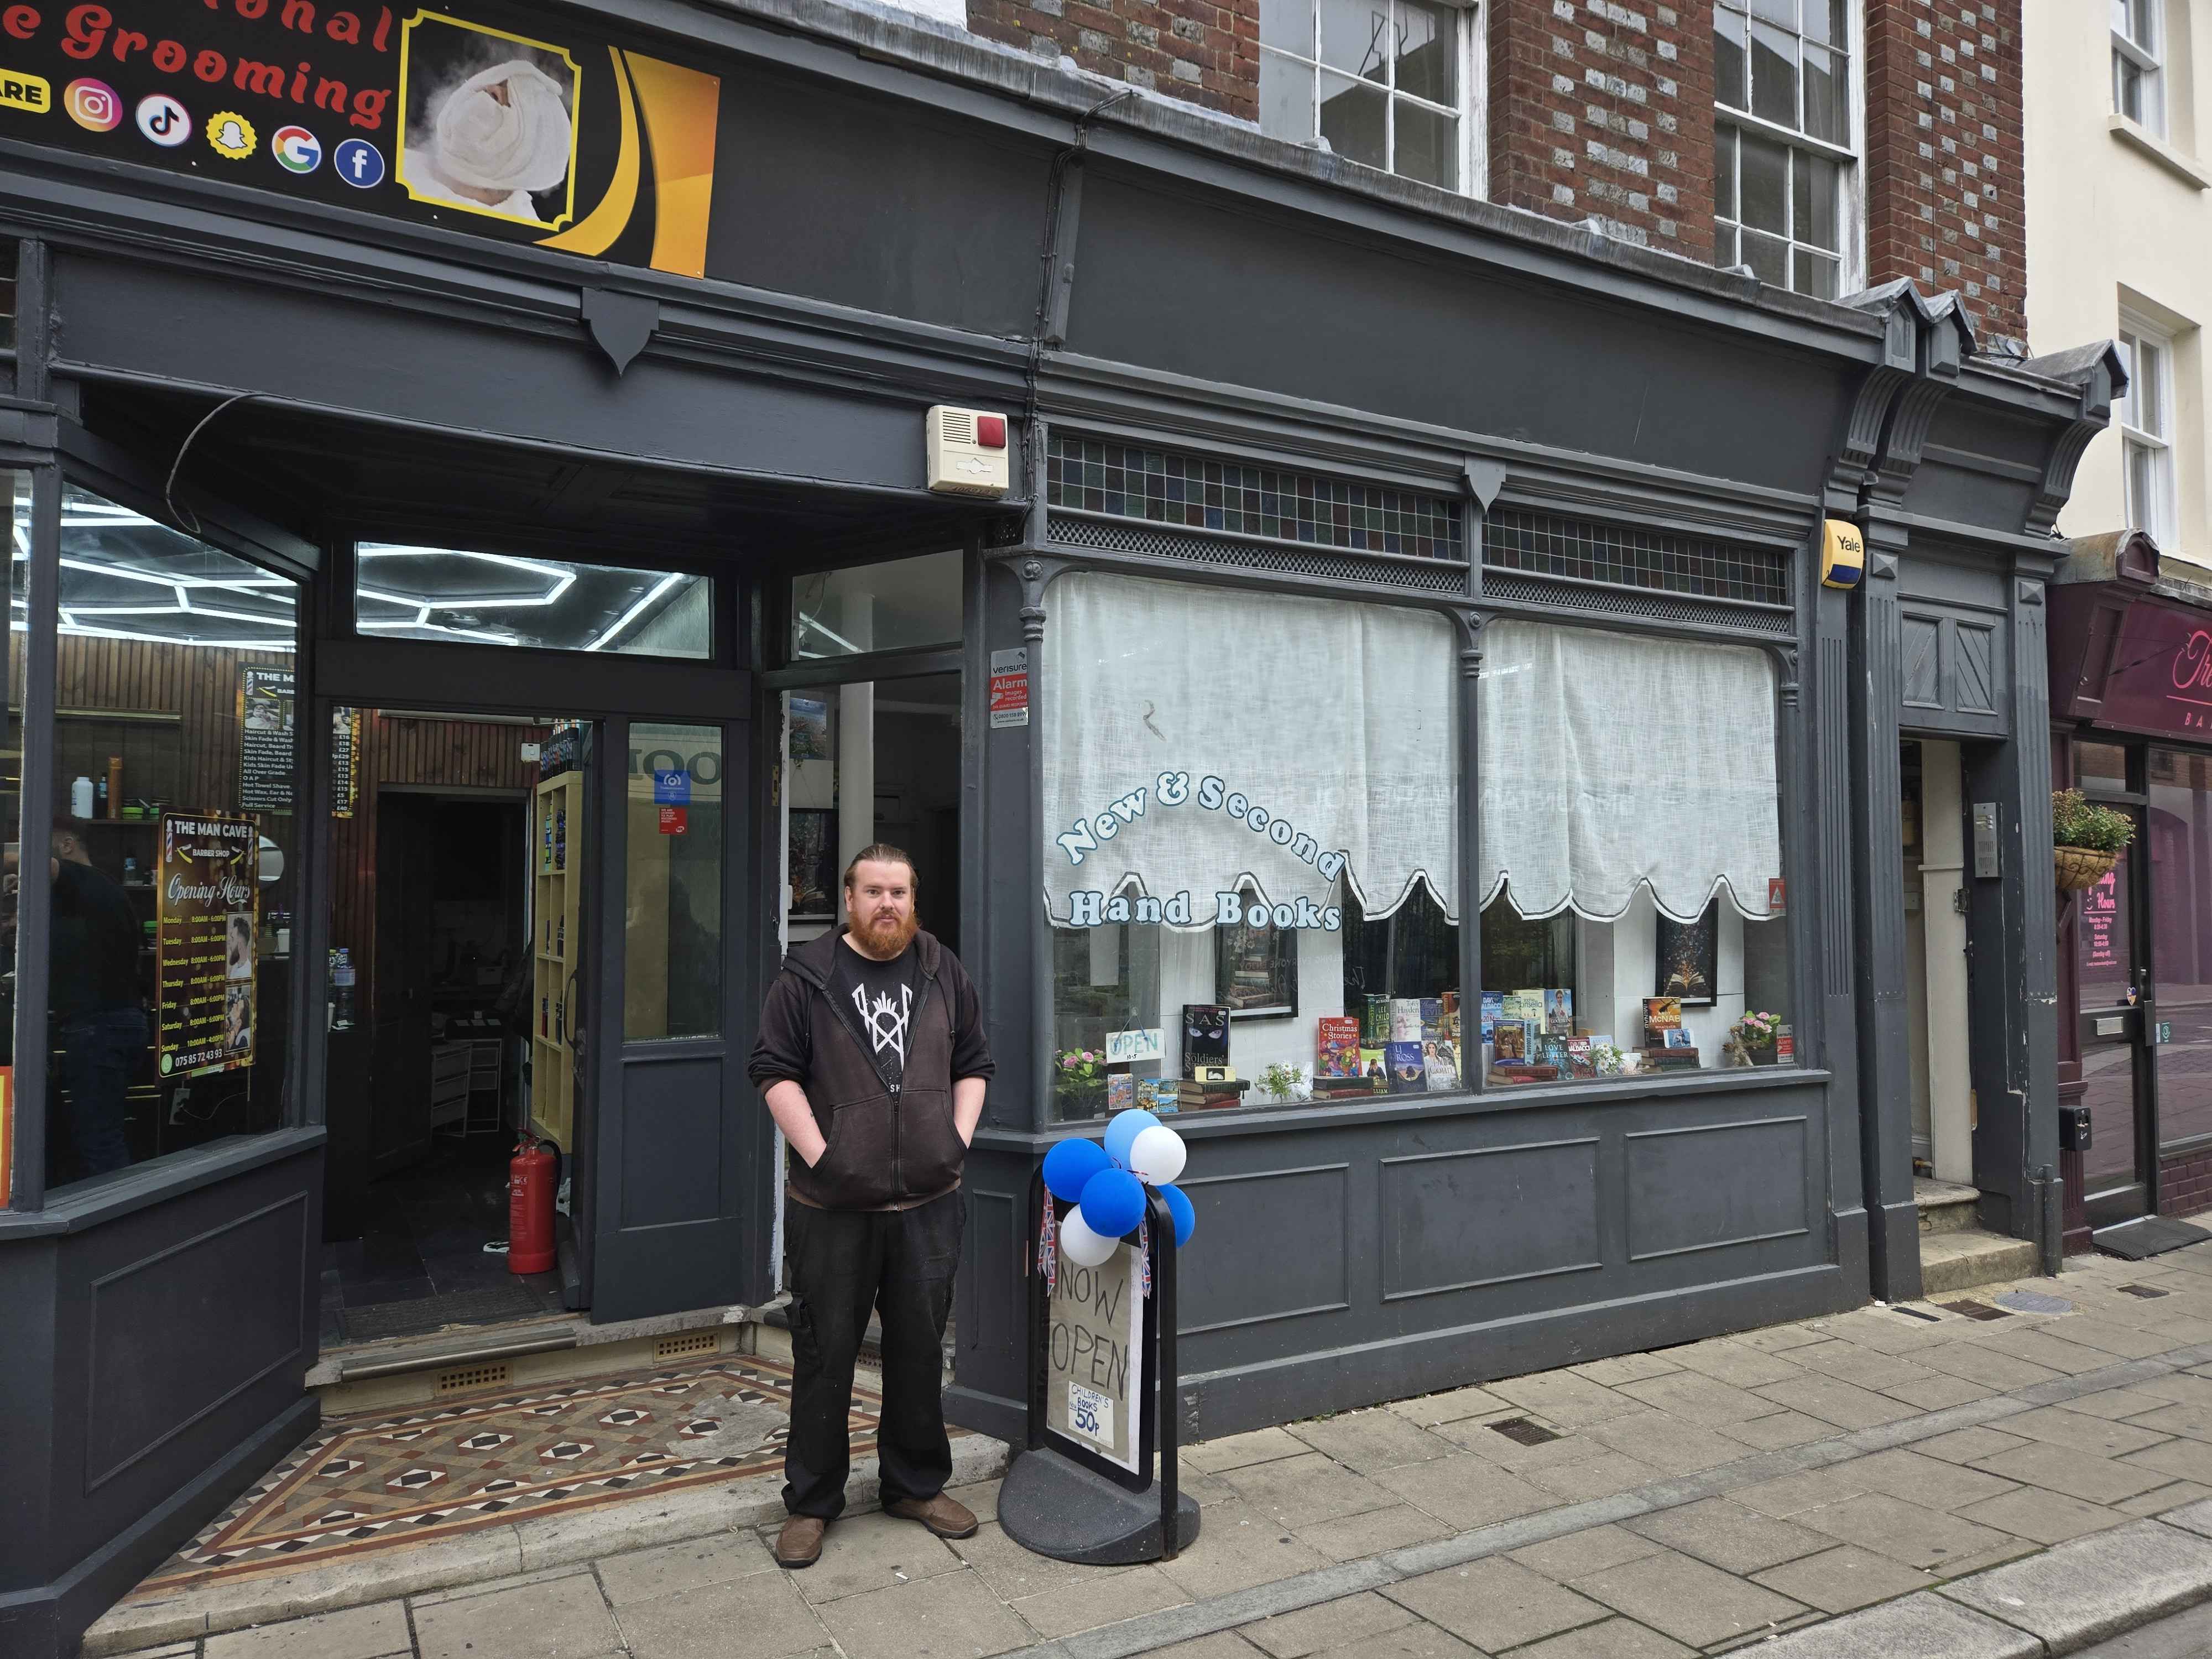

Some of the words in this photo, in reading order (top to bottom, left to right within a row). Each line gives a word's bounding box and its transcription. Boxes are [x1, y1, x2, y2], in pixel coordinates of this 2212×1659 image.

[204, 0, 393, 53] onal
[61, 5, 392, 129] Grooming
[0, 80, 43, 105] RE
[1837, 535, 1860, 552] Yale
[256, 672, 281, 681] THE
[993, 663, 1027, 674] verisure
[993, 678, 1027, 691] Alarm
[2184, 712, 2212, 730] BA
[174, 821, 195, 834] THE
[197, 823, 220, 836] MAN
[222, 825, 247, 838] CAVE
[1057, 787, 1147, 866] New
[1156, 771, 1190, 806] &
[1198, 775, 1346, 883] Second
[192, 849, 215, 857] BARBER
[168, 873, 216, 907] Opening
[216, 875, 251, 905] Hours
[2097, 891, 2115, 909] Hours
[1068, 890, 1192, 926] Hand
[1215, 891, 1342, 932] Books
[163, 916, 182, 925] Monday
[163, 937, 182, 946] Tuesday
[163, 958, 189, 967] Wednesday
[162, 979, 184, 988] Thursday
[210, 974, 225, 983] 6:00PM
[162, 1001, 177, 1010] Friday
[190, 997, 207, 1005] 8:00AM
[209, 994, 225, 1003] 6:00PM
[161, 1021, 183, 1031] Saturday
[190, 1018, 207, 1026] 8:00AM
[209, 1014, 225, 1023] 6:00PM
[1376, 1013, 1390, 1021] CHILD
[1322, 1024, 1358, 1033] Christmas
[161, 1043, 179, 1052] Sunday
[187, 1038, 206, 1047] 10:00AM
[208, 1034, 225, 1043] 4:00PM
[1110, 1032, 1158, 1056] OPEN
[175, 1056, 187, 1067] 075
[189, 1055, 196, 1065] 85
[197, 1053, 205, 1062] 72
[206, 1051, 214, 1060] 43
[215, 1049, 222, 1058] 93
[1185, 1052, 1224, 1064] Soldiers'
[1396, 1053, 1415, 1062] ROSS
[1060, 1261, 1123, 1327] NOW
[1052, 1322, 1128, 1401] OPEN
[1071, 1384, 1109, 1408] CHILDREN'S
[1077, 1397, 1098, 1412] BOOKS
[1075, 1407, 1099, 1436] 50p
